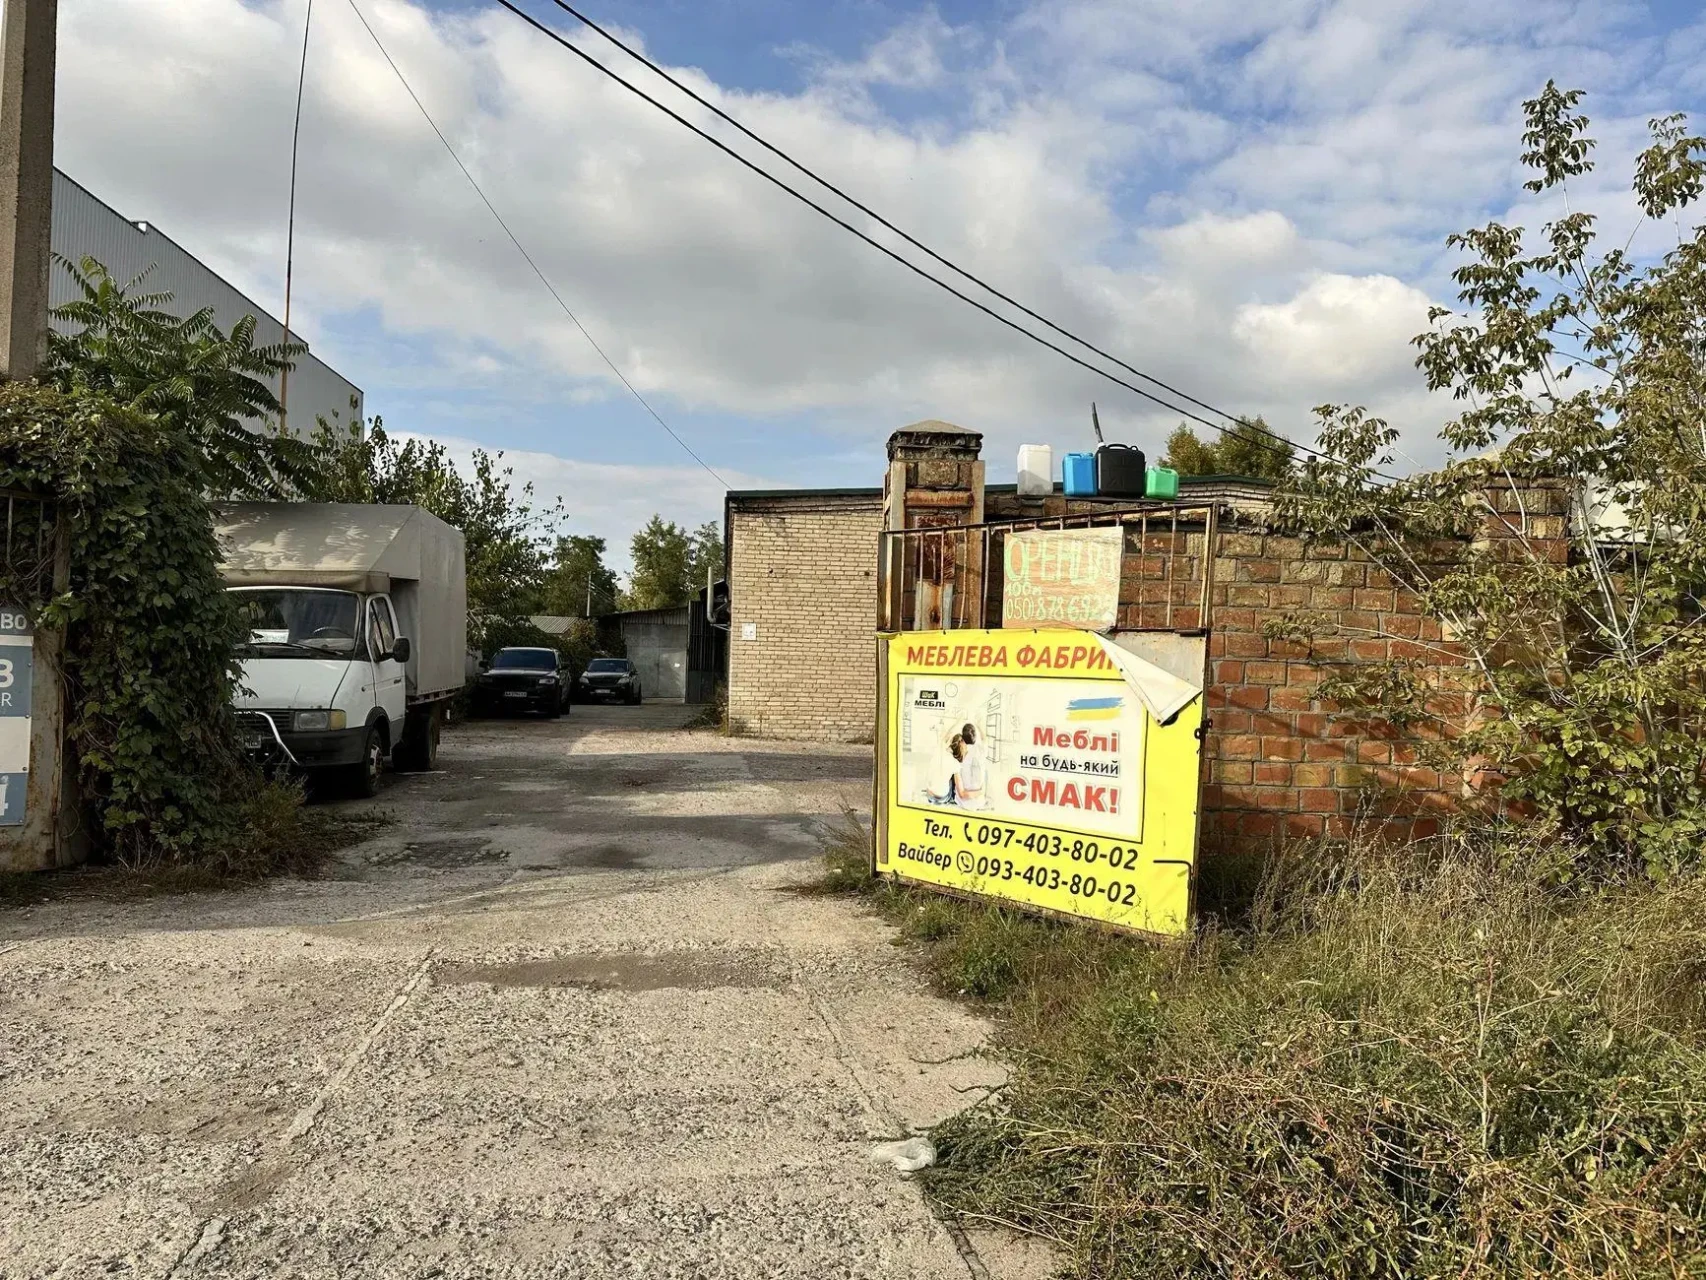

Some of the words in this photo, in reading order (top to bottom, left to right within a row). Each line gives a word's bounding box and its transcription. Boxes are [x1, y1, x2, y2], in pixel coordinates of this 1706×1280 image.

[906, 645, 1008, 668] МЕБЛЕВА
[914, 700, 945, 708] МЕБЛІ
[1033, 726, 1118, 753] Меблі
[1020, 754, 1038, 767] на
[1042, 754, 1119, 776] будь-який
[1007, 776, 1119, 814] СМАК!
[924, 818, 953, 840] Тел.
[977, 824, 1139, 871] 097-403-80-02
[898, 842, 952, 871] Вайбер
[976, 856, 1137, 906] 093-403-80-02
